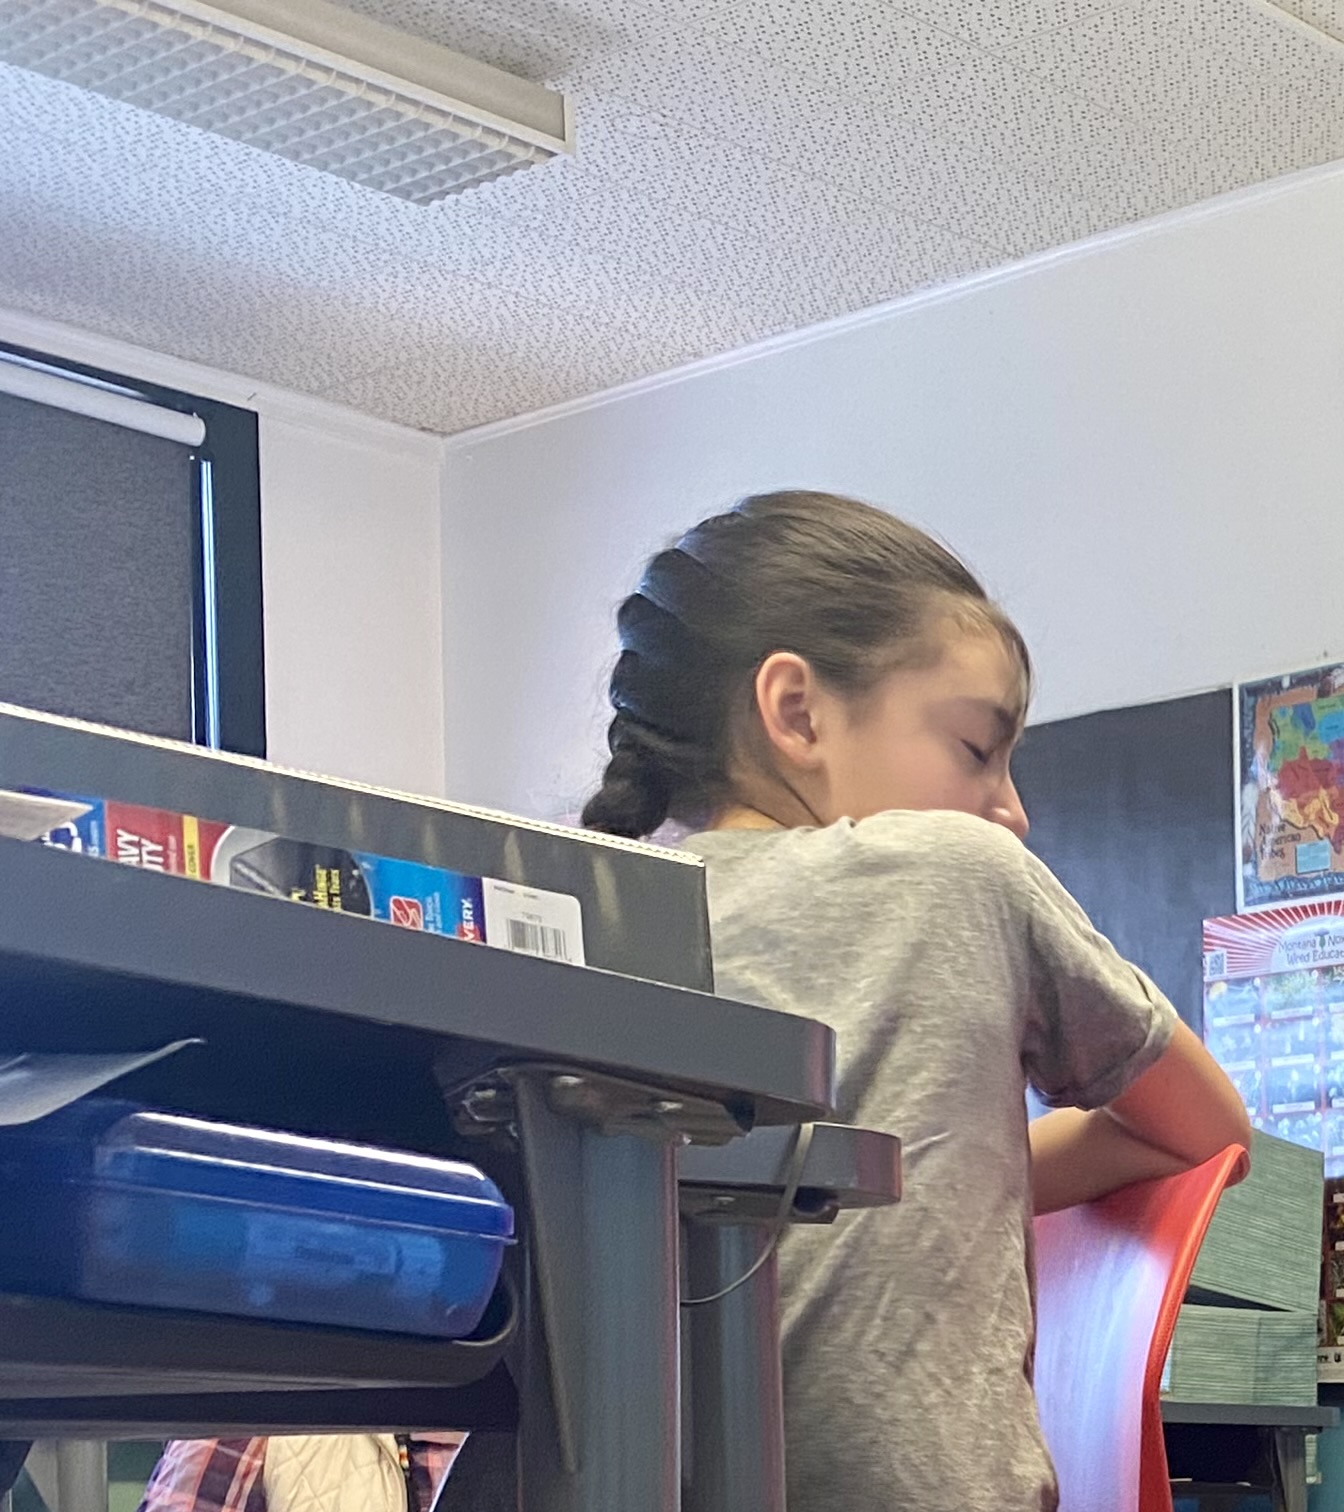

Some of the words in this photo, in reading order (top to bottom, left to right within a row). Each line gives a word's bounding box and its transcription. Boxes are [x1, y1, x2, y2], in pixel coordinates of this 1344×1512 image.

[117, 828, 140, 864] AVY
[461, 899, 473, 941] VERY
[1278, 937, 1316, 952] Montana
[1287, 952, 1310, 966] Weed
